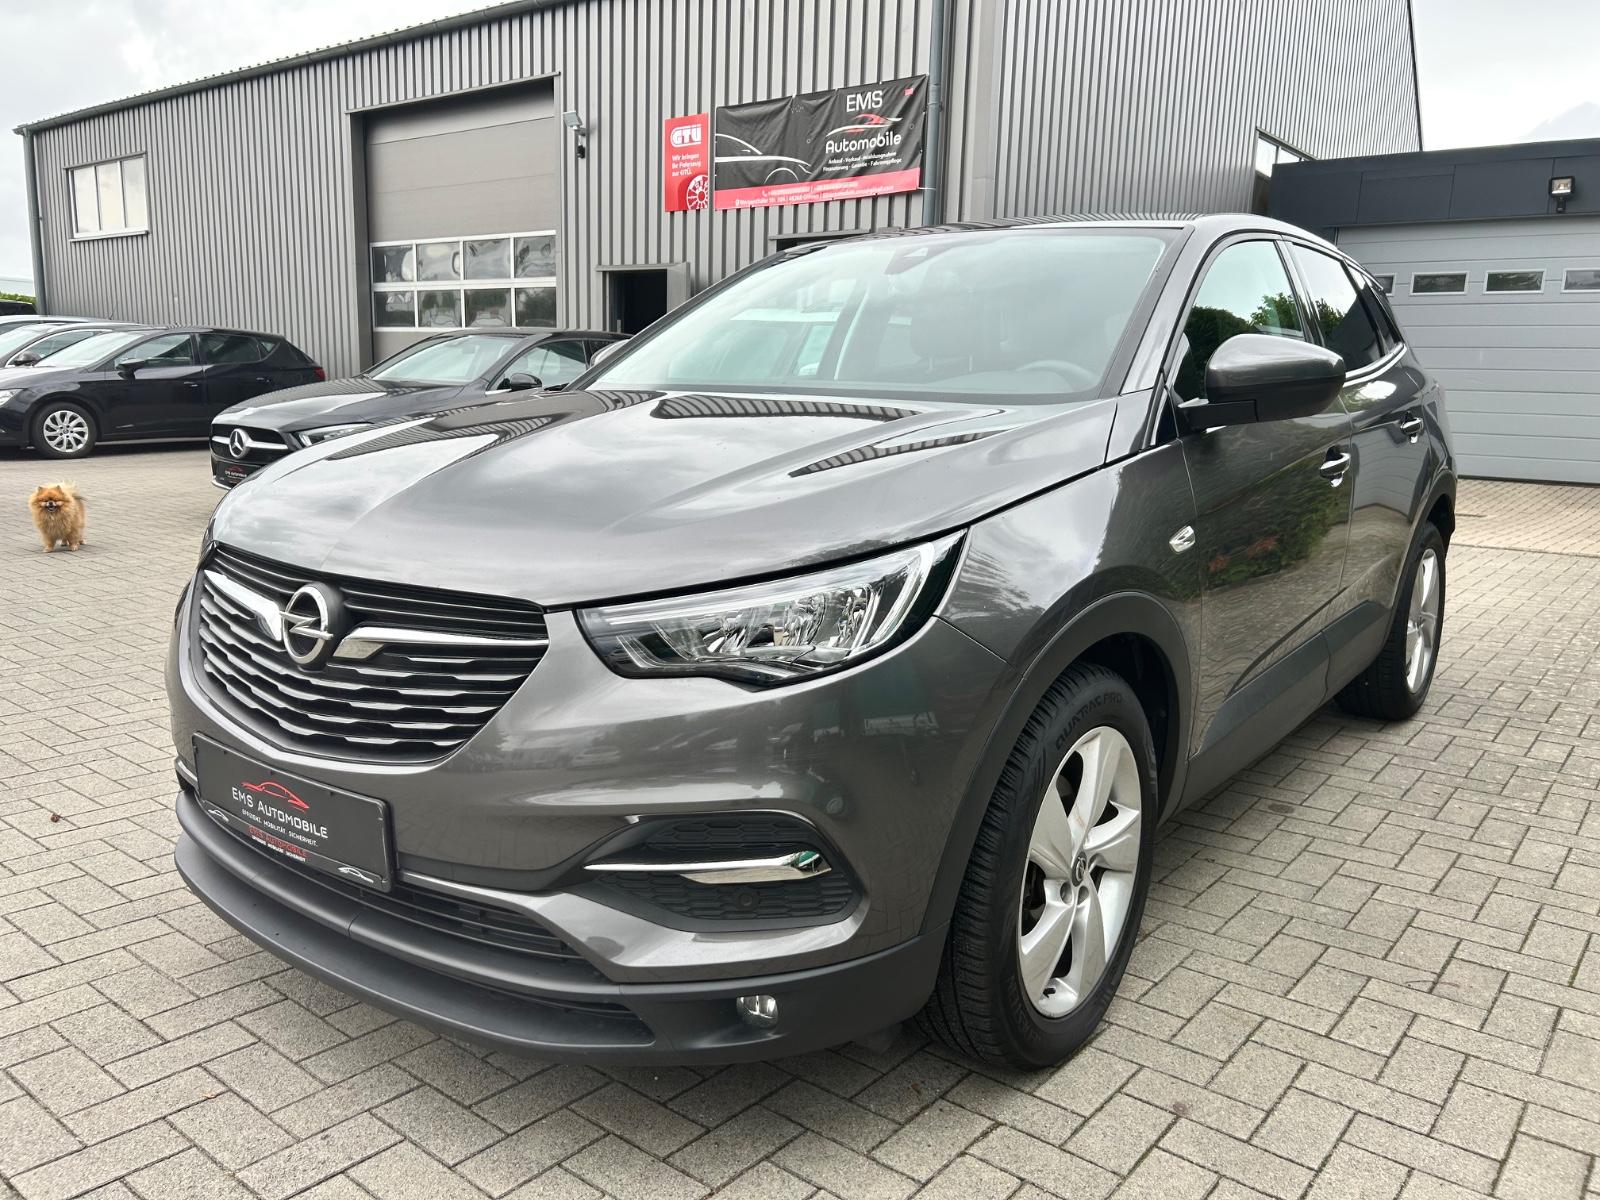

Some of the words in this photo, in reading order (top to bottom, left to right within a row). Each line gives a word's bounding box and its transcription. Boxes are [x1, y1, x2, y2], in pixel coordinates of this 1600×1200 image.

[846, 90, 883, 112] EMS
[825, 131, 902, 154] Automobile
[231, 786, 254, 808] EMS
